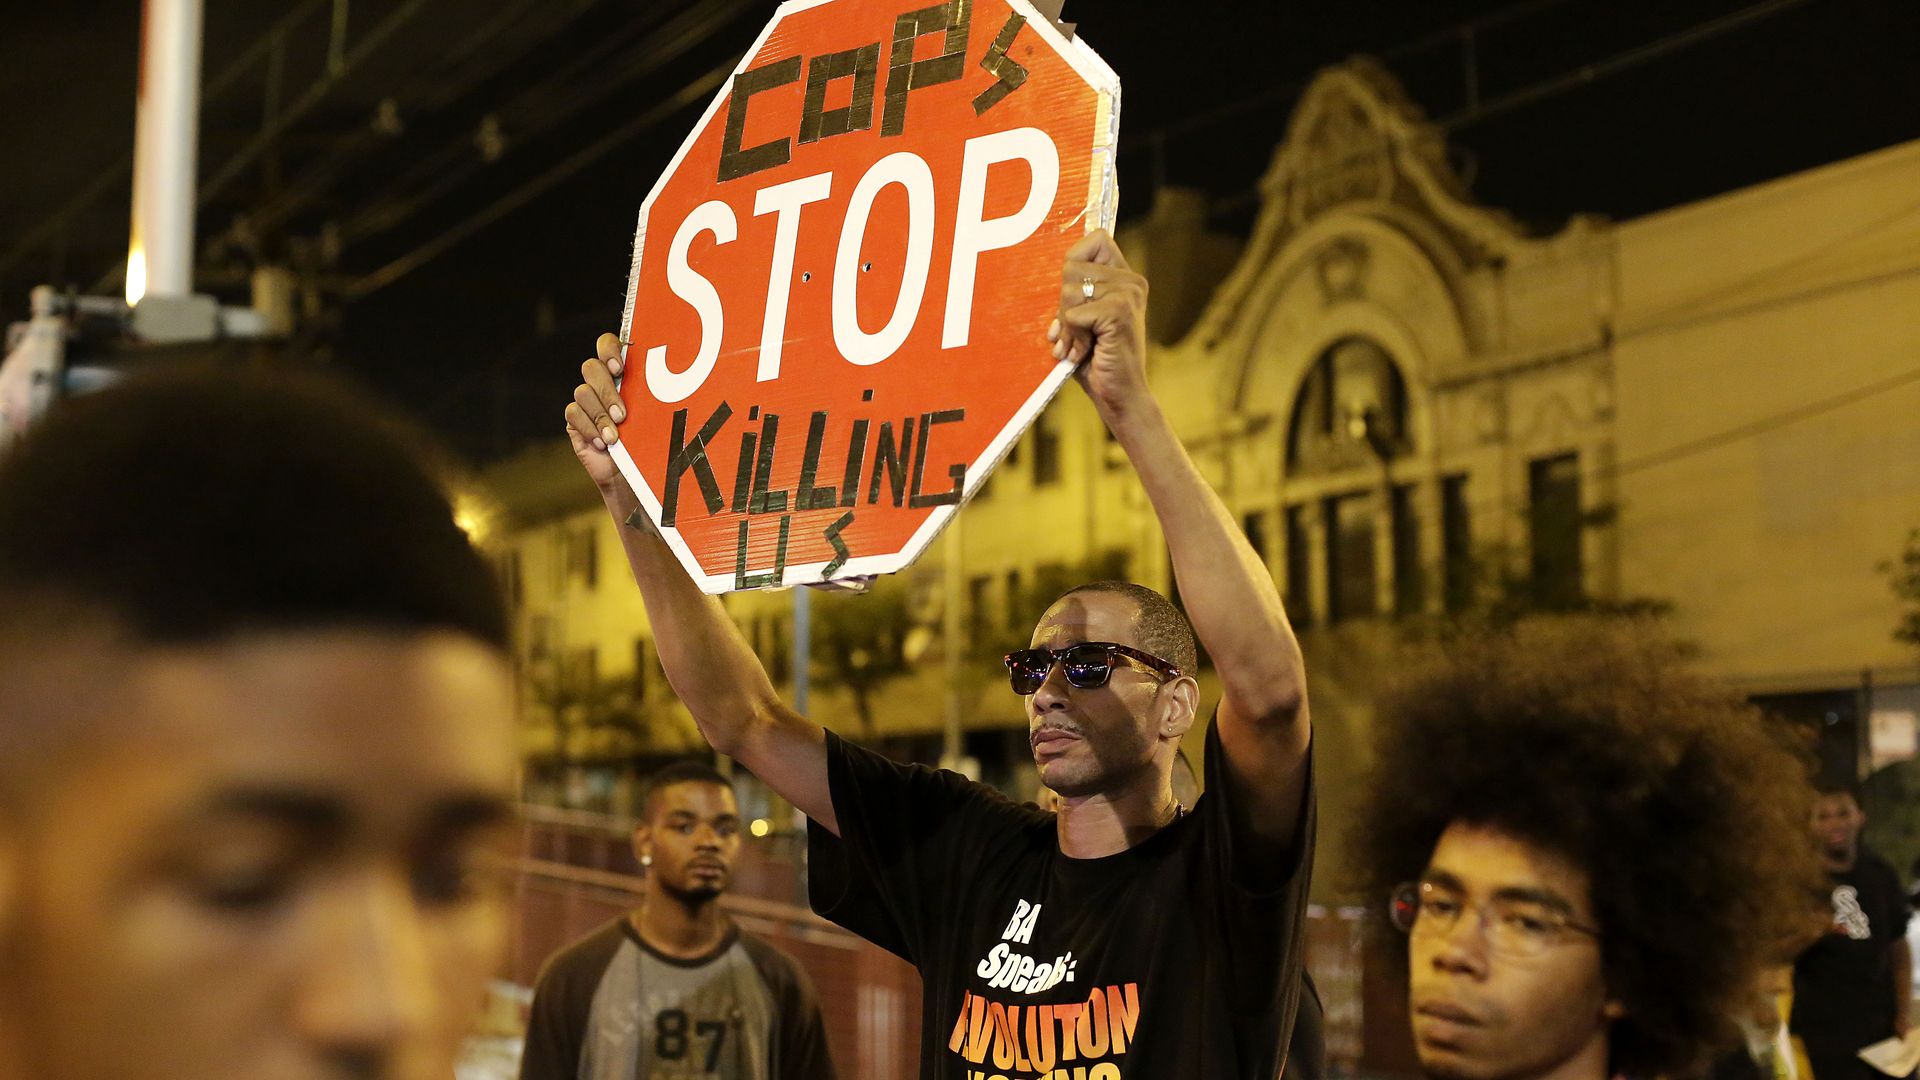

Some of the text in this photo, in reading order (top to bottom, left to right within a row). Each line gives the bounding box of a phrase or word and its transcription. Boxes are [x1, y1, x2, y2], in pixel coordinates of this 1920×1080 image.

[717, 0, 1029, 184] COPS
[645, 127, 1060, 403] STOP
[735, 511, 854, 590] US
[1001, 899, 1042, 945] BA
[655, 1009, 727, 1073] 87
